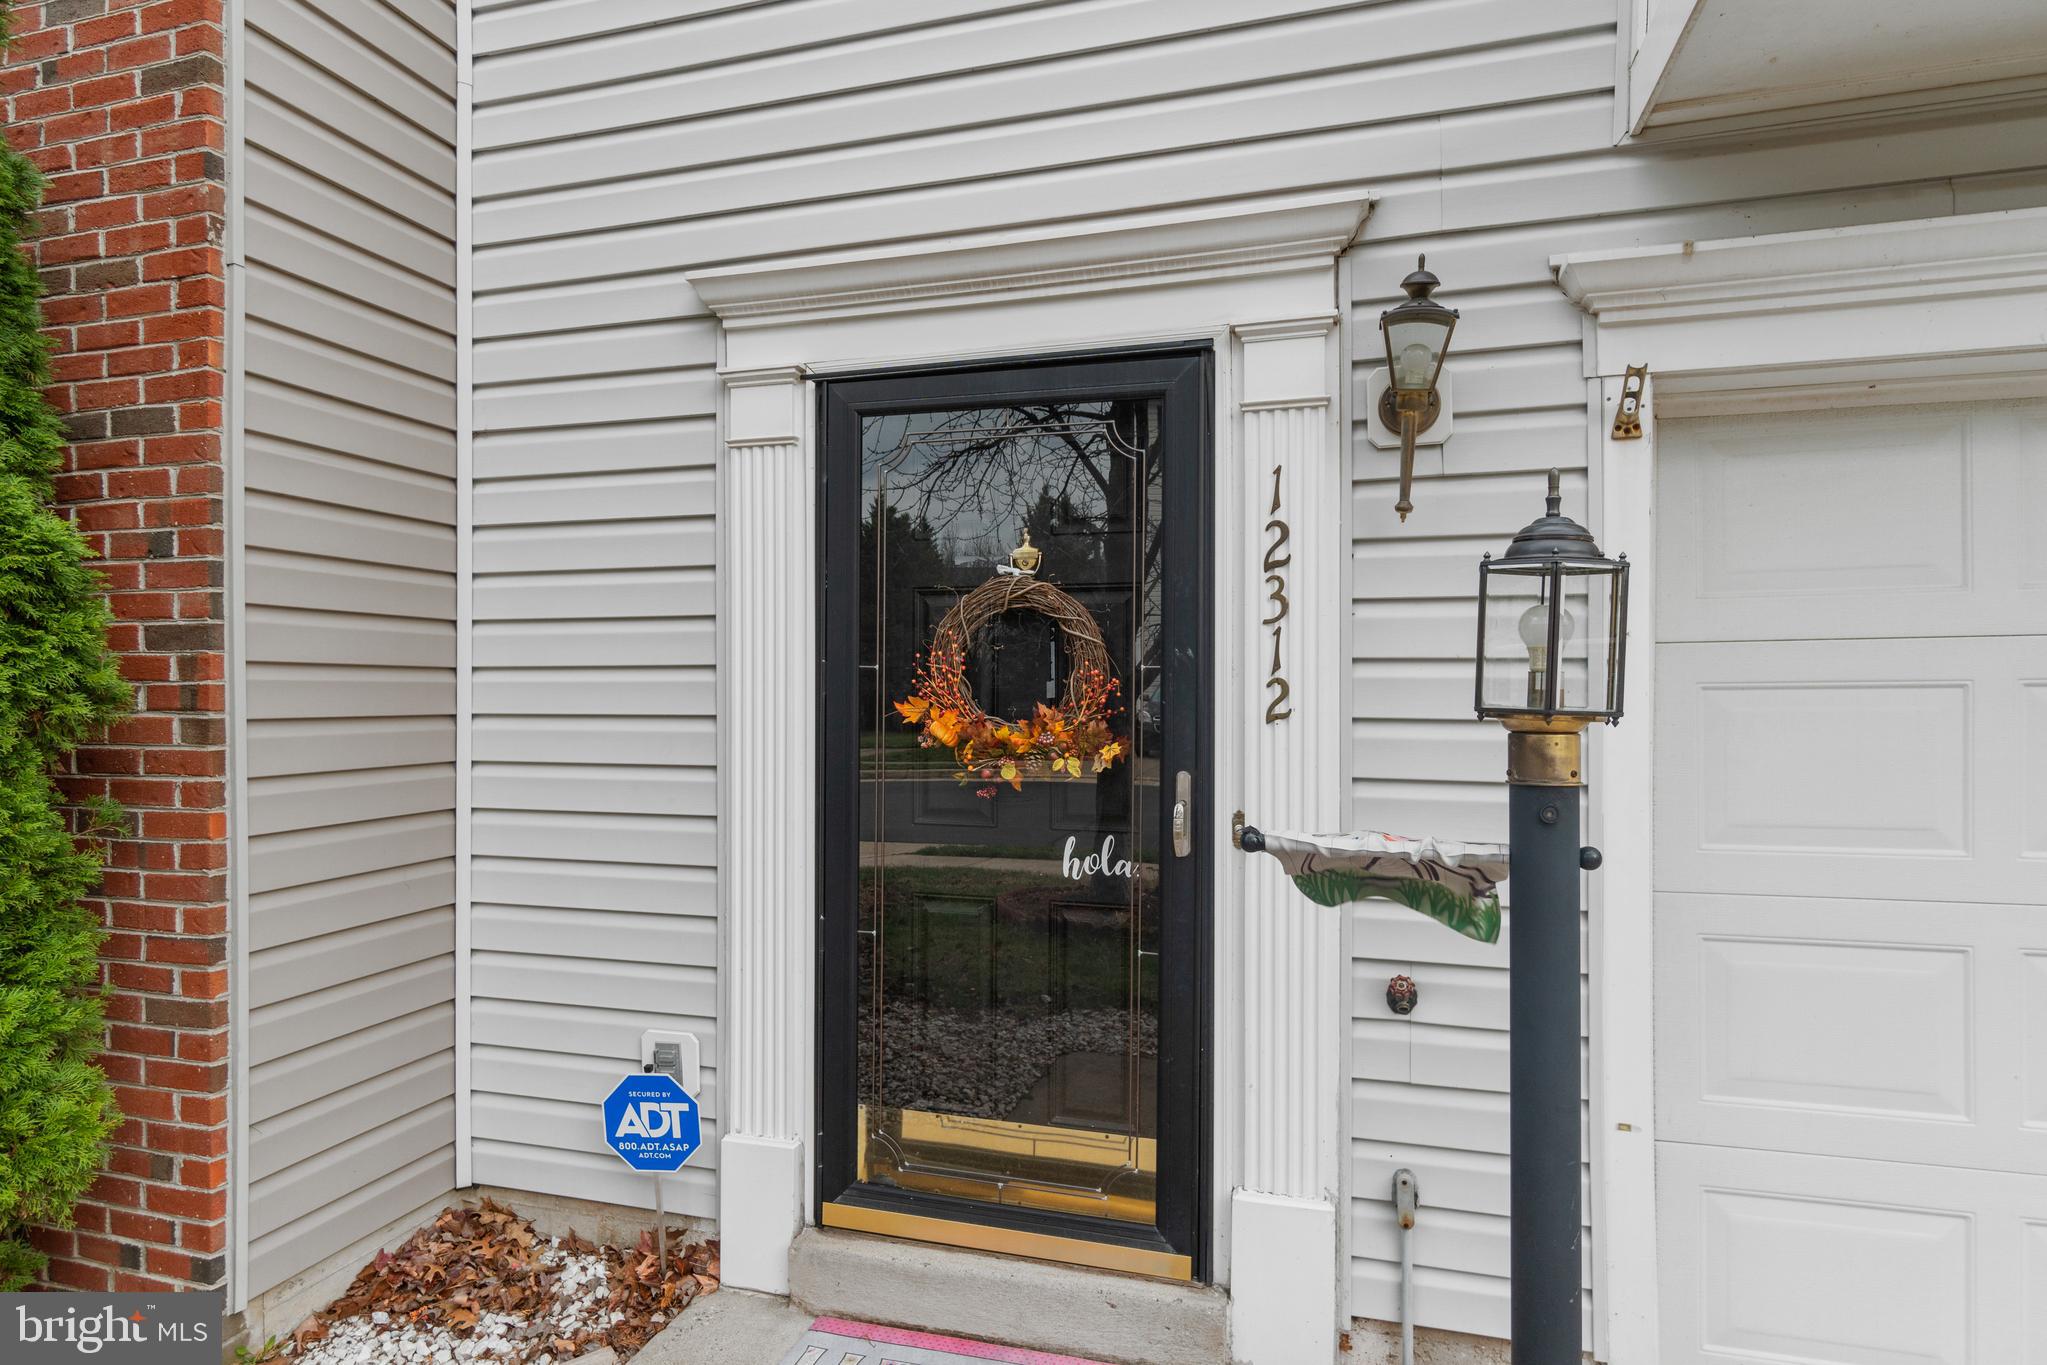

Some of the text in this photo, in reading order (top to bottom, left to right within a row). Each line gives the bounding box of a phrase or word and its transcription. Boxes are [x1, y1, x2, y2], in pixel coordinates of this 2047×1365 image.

[1262, 464, 1292, 725] 12312
[615, 1102, 689, 1138] ADT
[618, 1142, 690, 1151] 800.ADT.ASAP
[638, 1152, 672, 1160] ADT.COM
